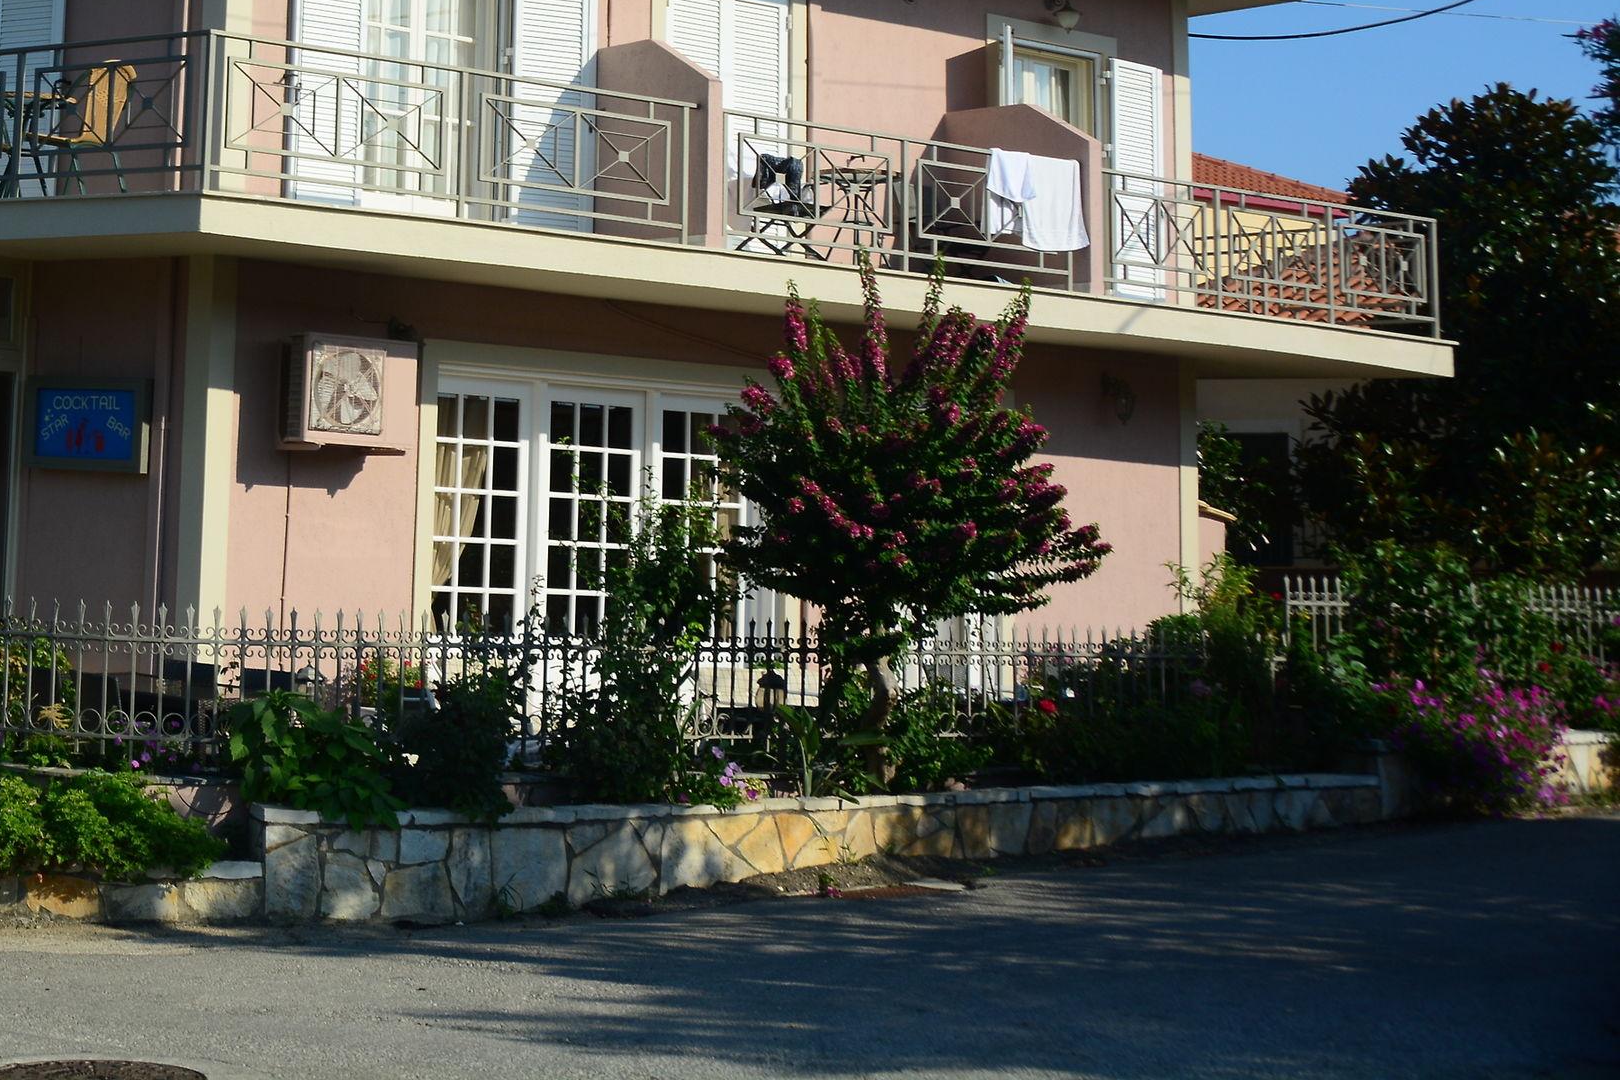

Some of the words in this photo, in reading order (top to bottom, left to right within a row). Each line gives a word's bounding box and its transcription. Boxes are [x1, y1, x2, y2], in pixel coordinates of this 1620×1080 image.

[53, 395, 121, 410] COCKTAIL
[41, 414, 69, 441] STAR
[106, 415, 131, 440] BAR
